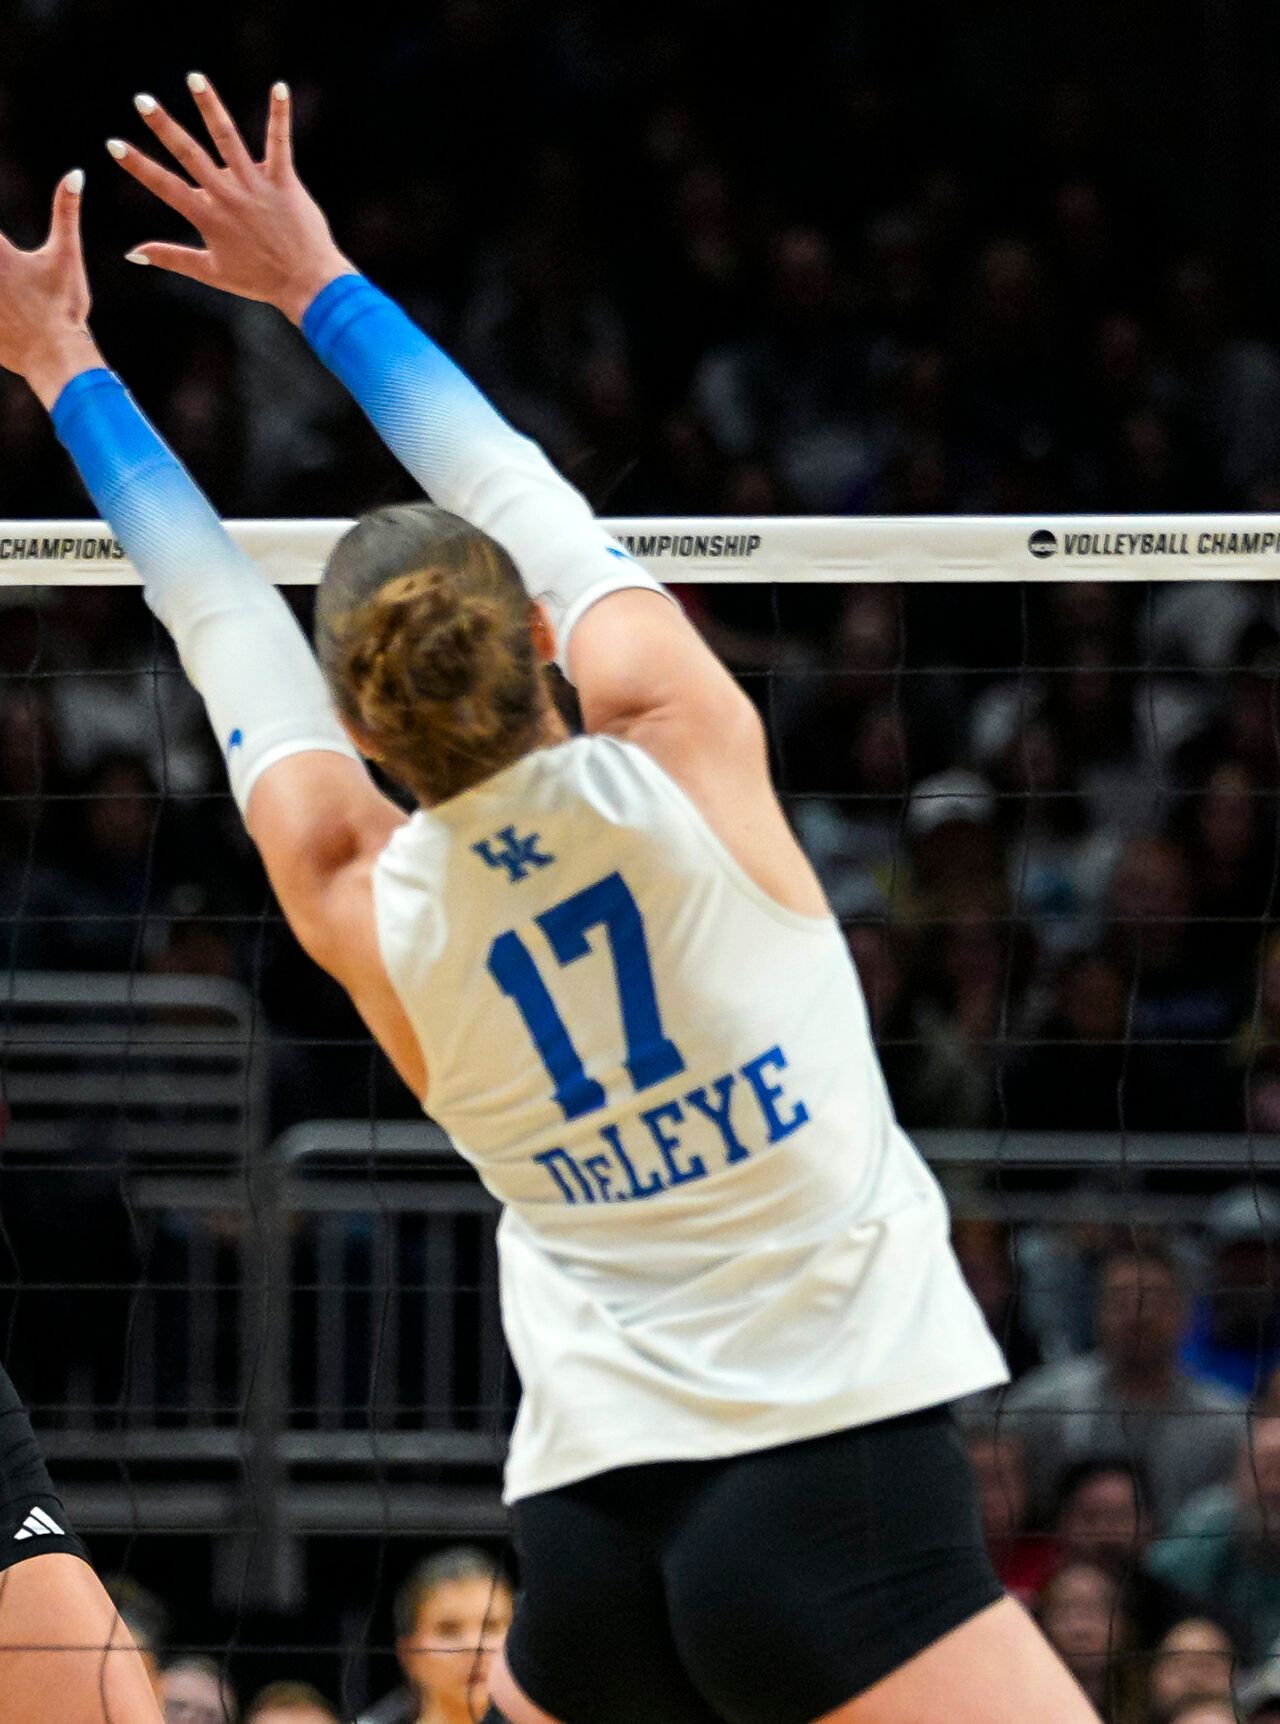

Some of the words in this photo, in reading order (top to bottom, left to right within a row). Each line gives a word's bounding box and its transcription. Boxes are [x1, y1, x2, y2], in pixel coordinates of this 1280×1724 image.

[617, 535, 761, 557] AMPIONSHIP
[1063, 533, 1189, 555] VOLLEYBALL
[470, 825, 557, 884] UK
[486, 870, 687, 1122] 17
